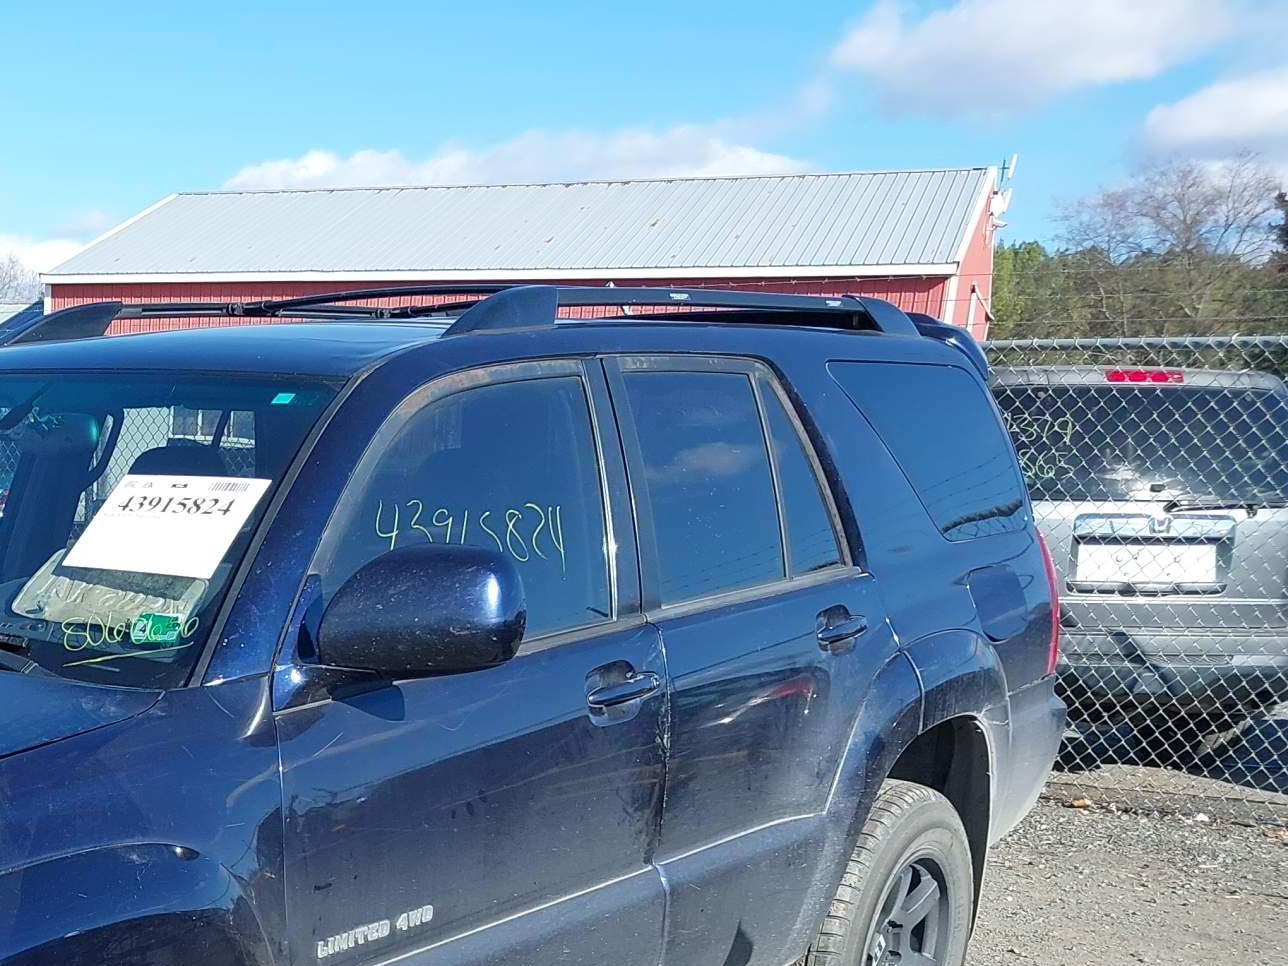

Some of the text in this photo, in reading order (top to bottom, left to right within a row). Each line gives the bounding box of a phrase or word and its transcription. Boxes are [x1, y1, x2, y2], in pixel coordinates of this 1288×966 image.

[117, 495, 236, 516] 43915824
[317, 904, 434, 959] LIMITED 4WD
